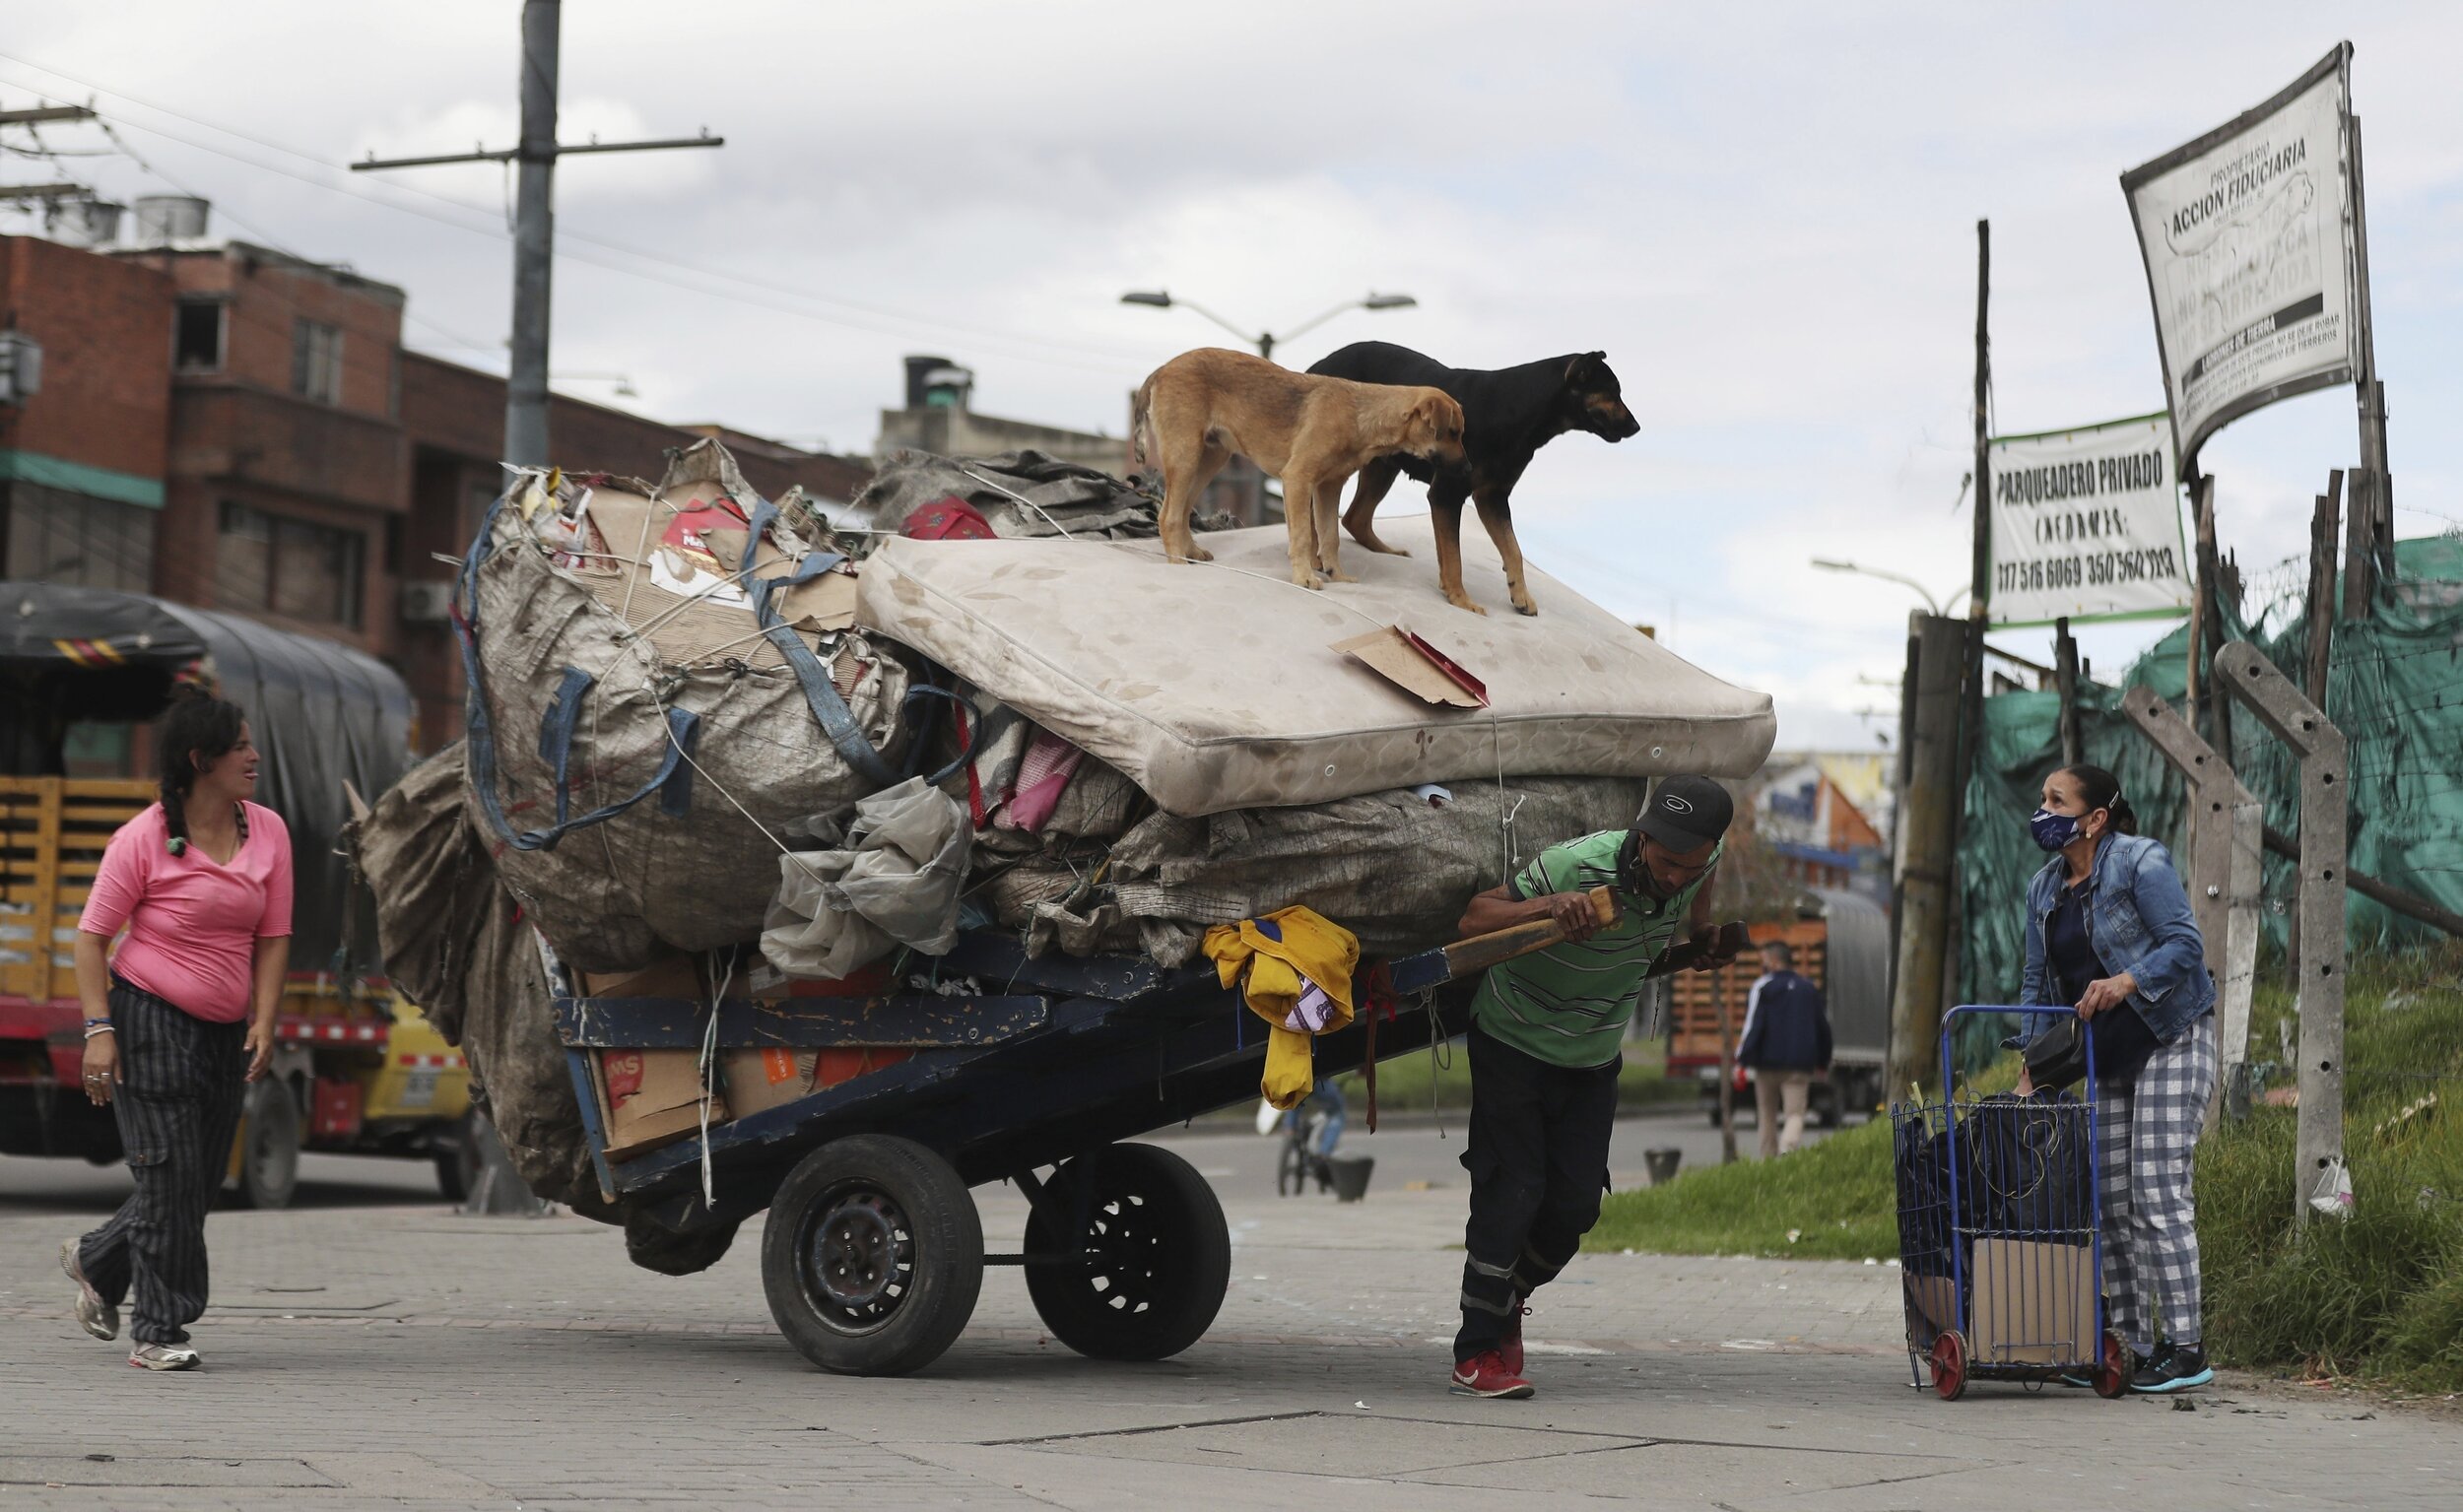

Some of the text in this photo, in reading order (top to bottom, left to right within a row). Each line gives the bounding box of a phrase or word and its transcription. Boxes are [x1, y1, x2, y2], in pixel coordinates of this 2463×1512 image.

[2172, 186, 2225, 238] ACCION
[2228, 136, 2306, 204] FIDUCIARIA
[1997, 449, 2163, 507] PARQUEADERO PRIVADO
[2046, 556, 2082, 590] 6069
[2087, 552, 2114, 586] 350
